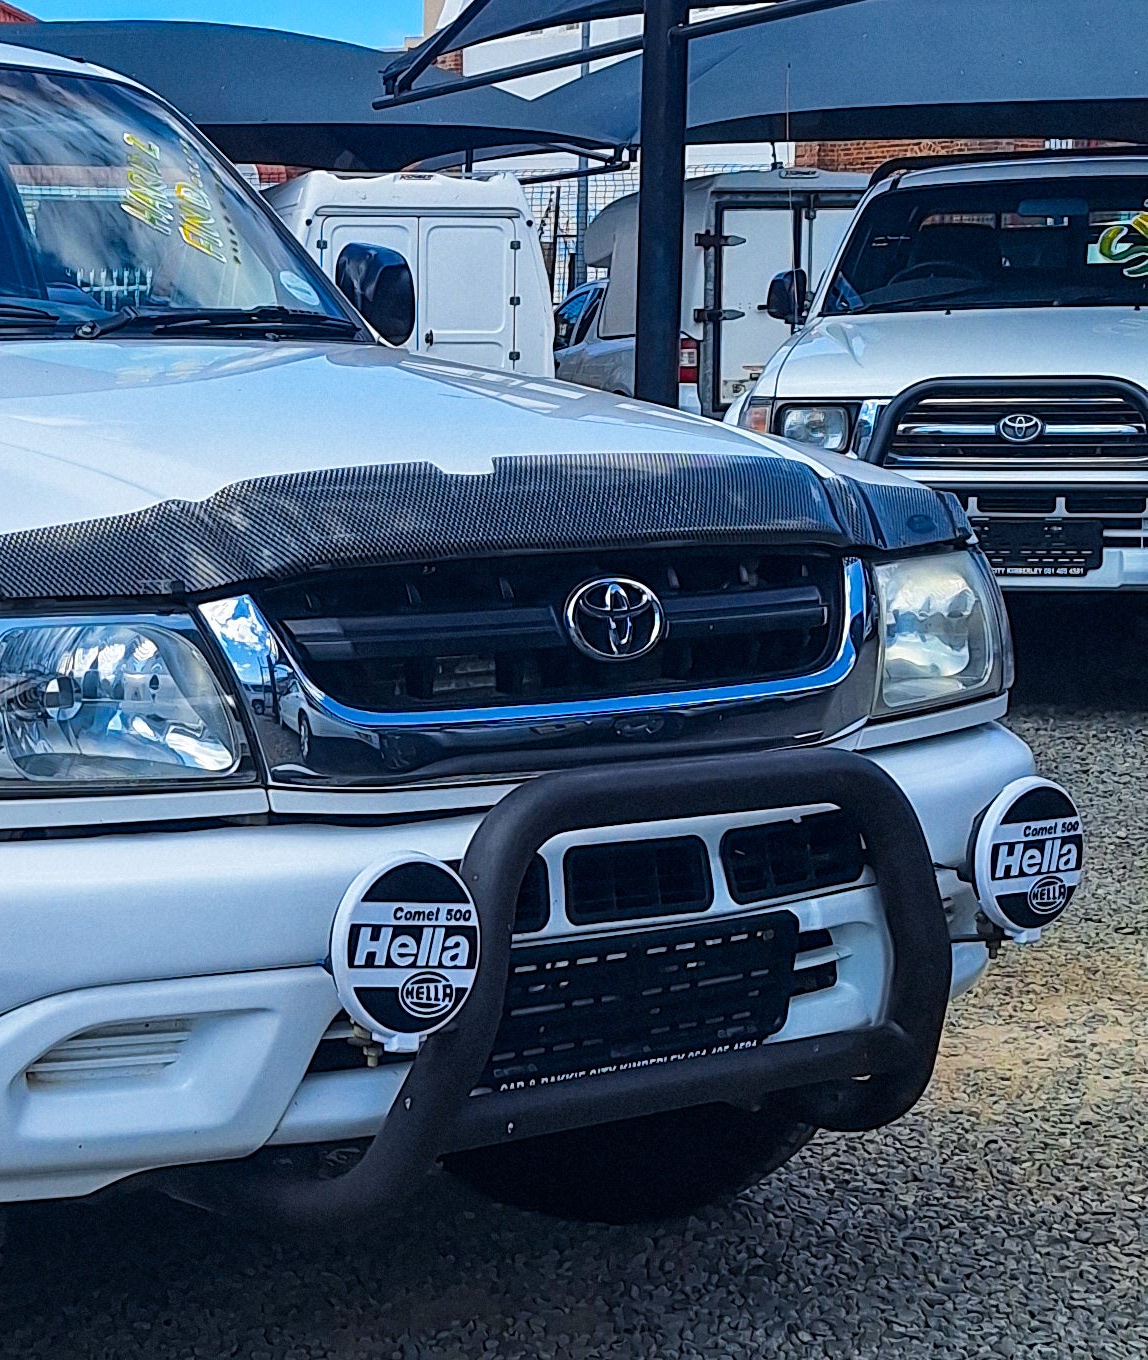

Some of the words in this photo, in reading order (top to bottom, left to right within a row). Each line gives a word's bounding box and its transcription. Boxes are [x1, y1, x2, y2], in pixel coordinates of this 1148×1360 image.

[1023, 824, 1057, 837] Comet
[1061, 821, 1080, 833] 500
[995, 839, 1078, 878] Hella
[1032, 884, 1066, 901] HELLA
[393, 907, 440, 921] Comet
[445, 909, 472, 921] 500
[353, 927, 470, 967] Hella
[405, 984, 453, 1003] HELLA
